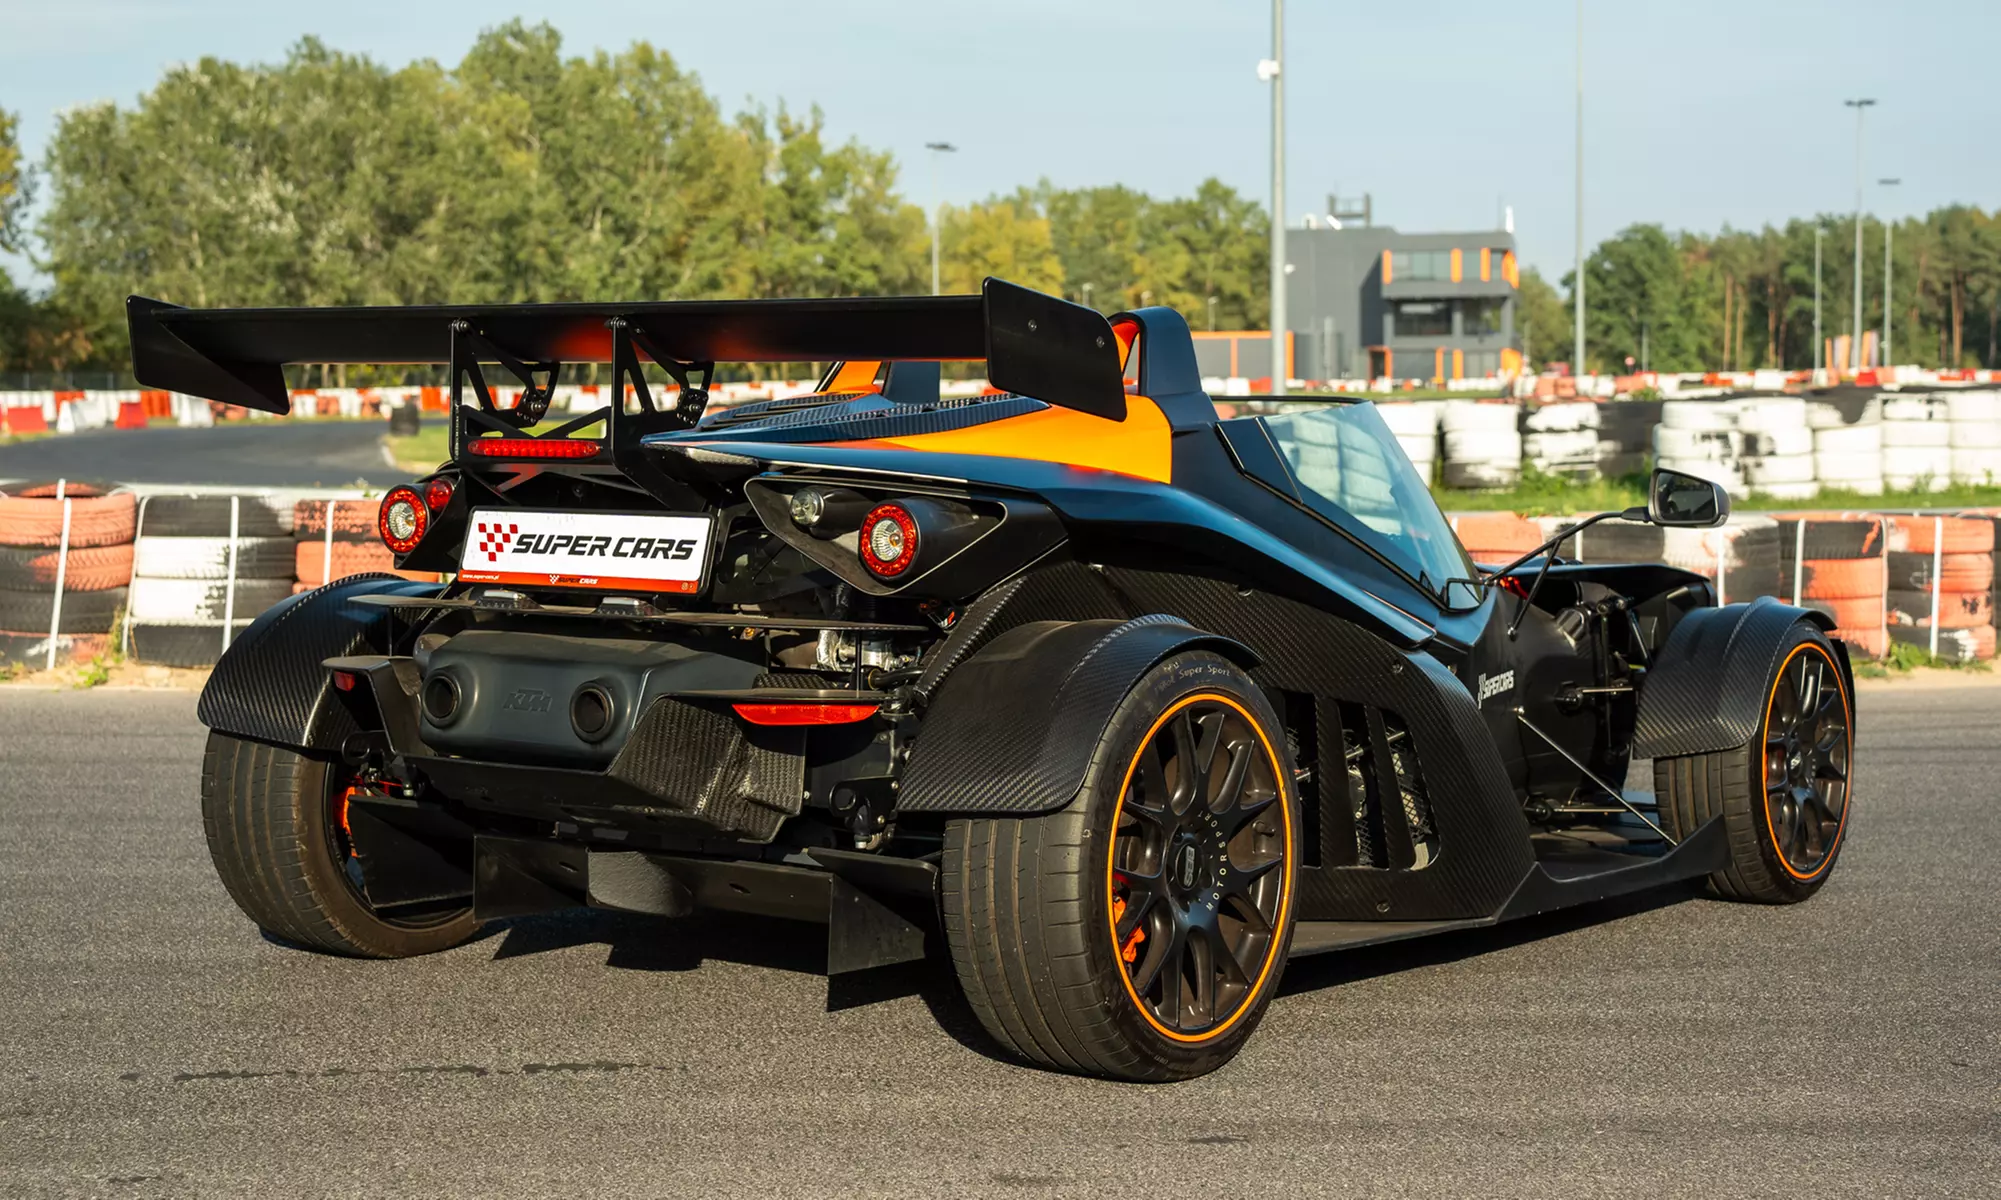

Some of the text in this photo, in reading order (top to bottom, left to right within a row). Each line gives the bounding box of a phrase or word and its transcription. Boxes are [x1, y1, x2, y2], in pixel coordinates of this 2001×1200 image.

[512, 534, 697, 560] SUPER CARS
[1179, 666, 1203, 680] Super
[1207, 664, 1231, 677] Sport
[502, 687, 553, 713] KTM
[1183, 845, 1196, 887] BBS
[1197, 810, 1228, 912] MOTORSPORT
